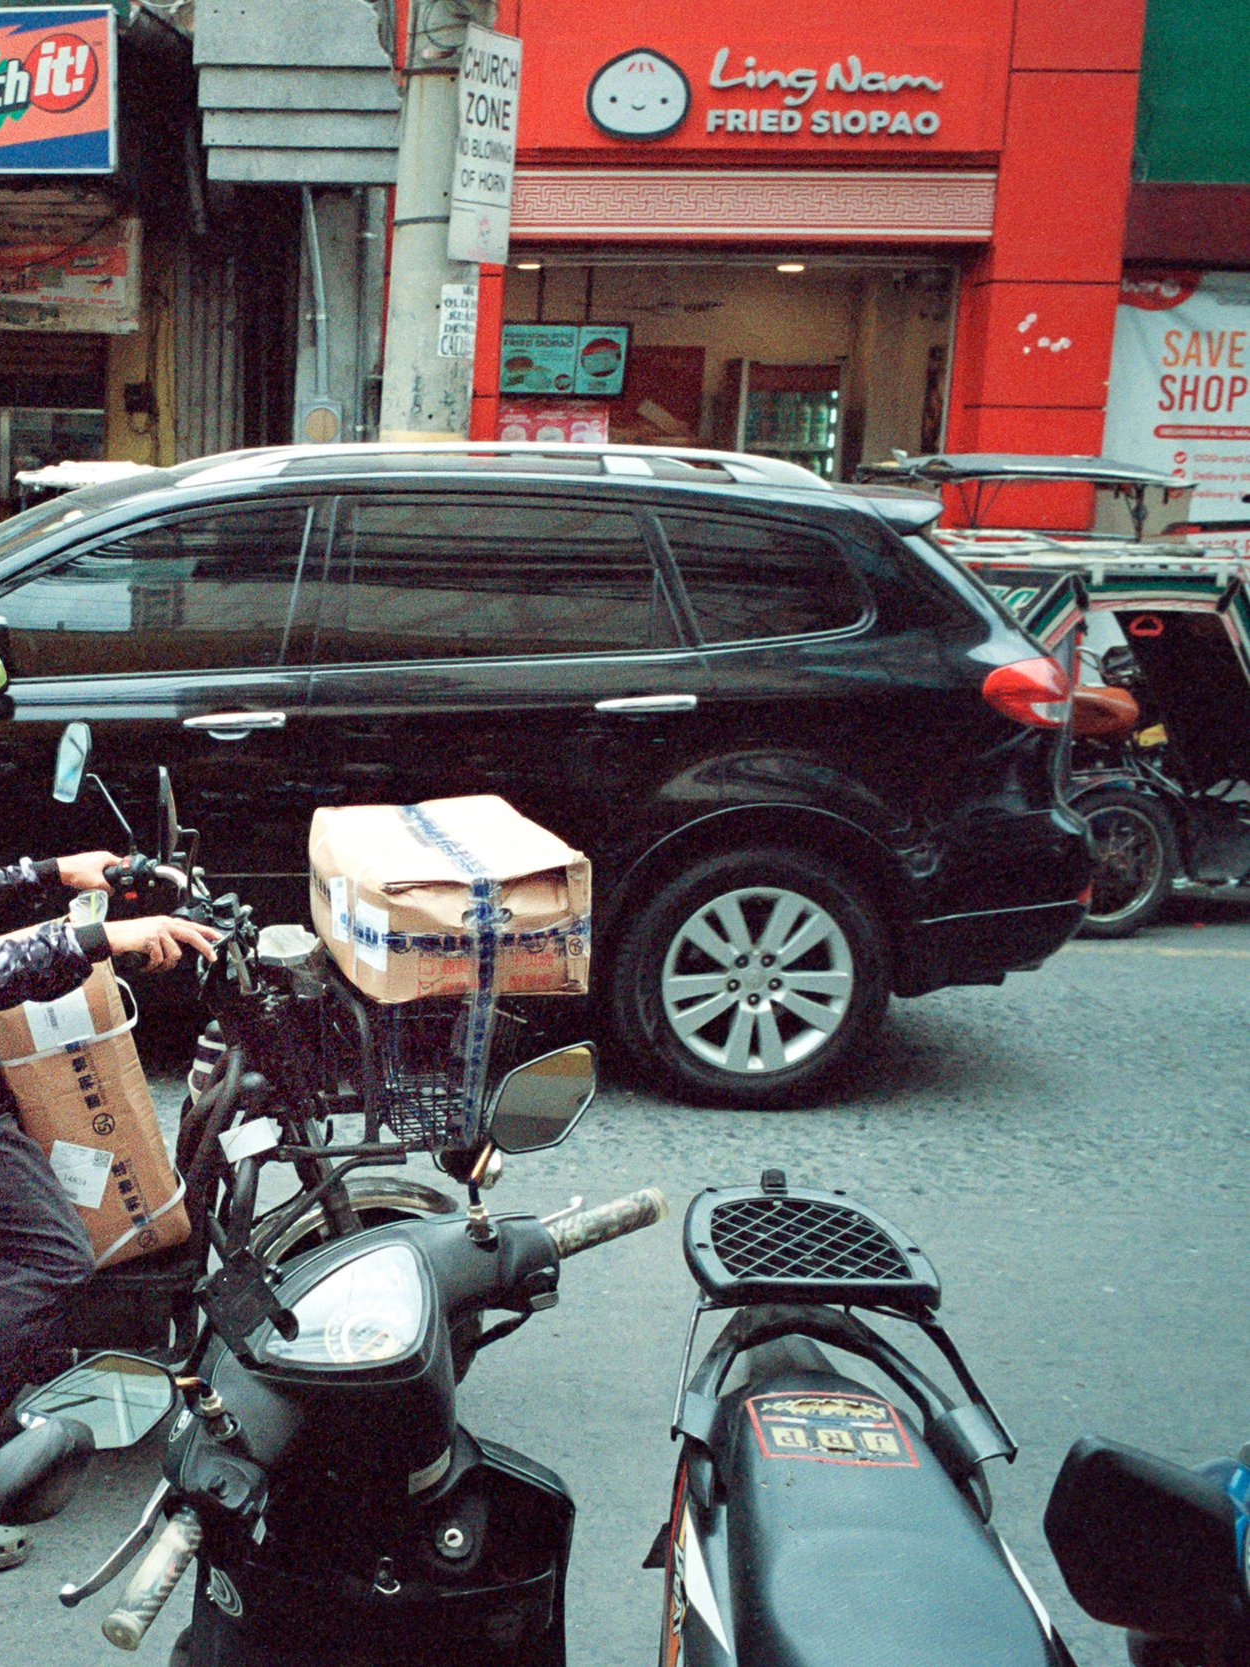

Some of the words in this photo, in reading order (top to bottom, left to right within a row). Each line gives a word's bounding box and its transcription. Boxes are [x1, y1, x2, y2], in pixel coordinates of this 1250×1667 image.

[34, 41, 89, 97] it!
[462, 47, 518, 90] CHURCH
[709, 48, 818, 106] Ling
[826, 55, 943, 92] Nam
[466, 91, 511, 131] ZONE
[706, 109, 803, 134] FRIED
[810, 110, 941, 136] SIOPAO
[460, 168, 476, 188] OF
[478, 172, 507, 193] HORN
[1160, 328, 1248, 369] SAVE
[1157, 373, 1249, 413] SHOP
